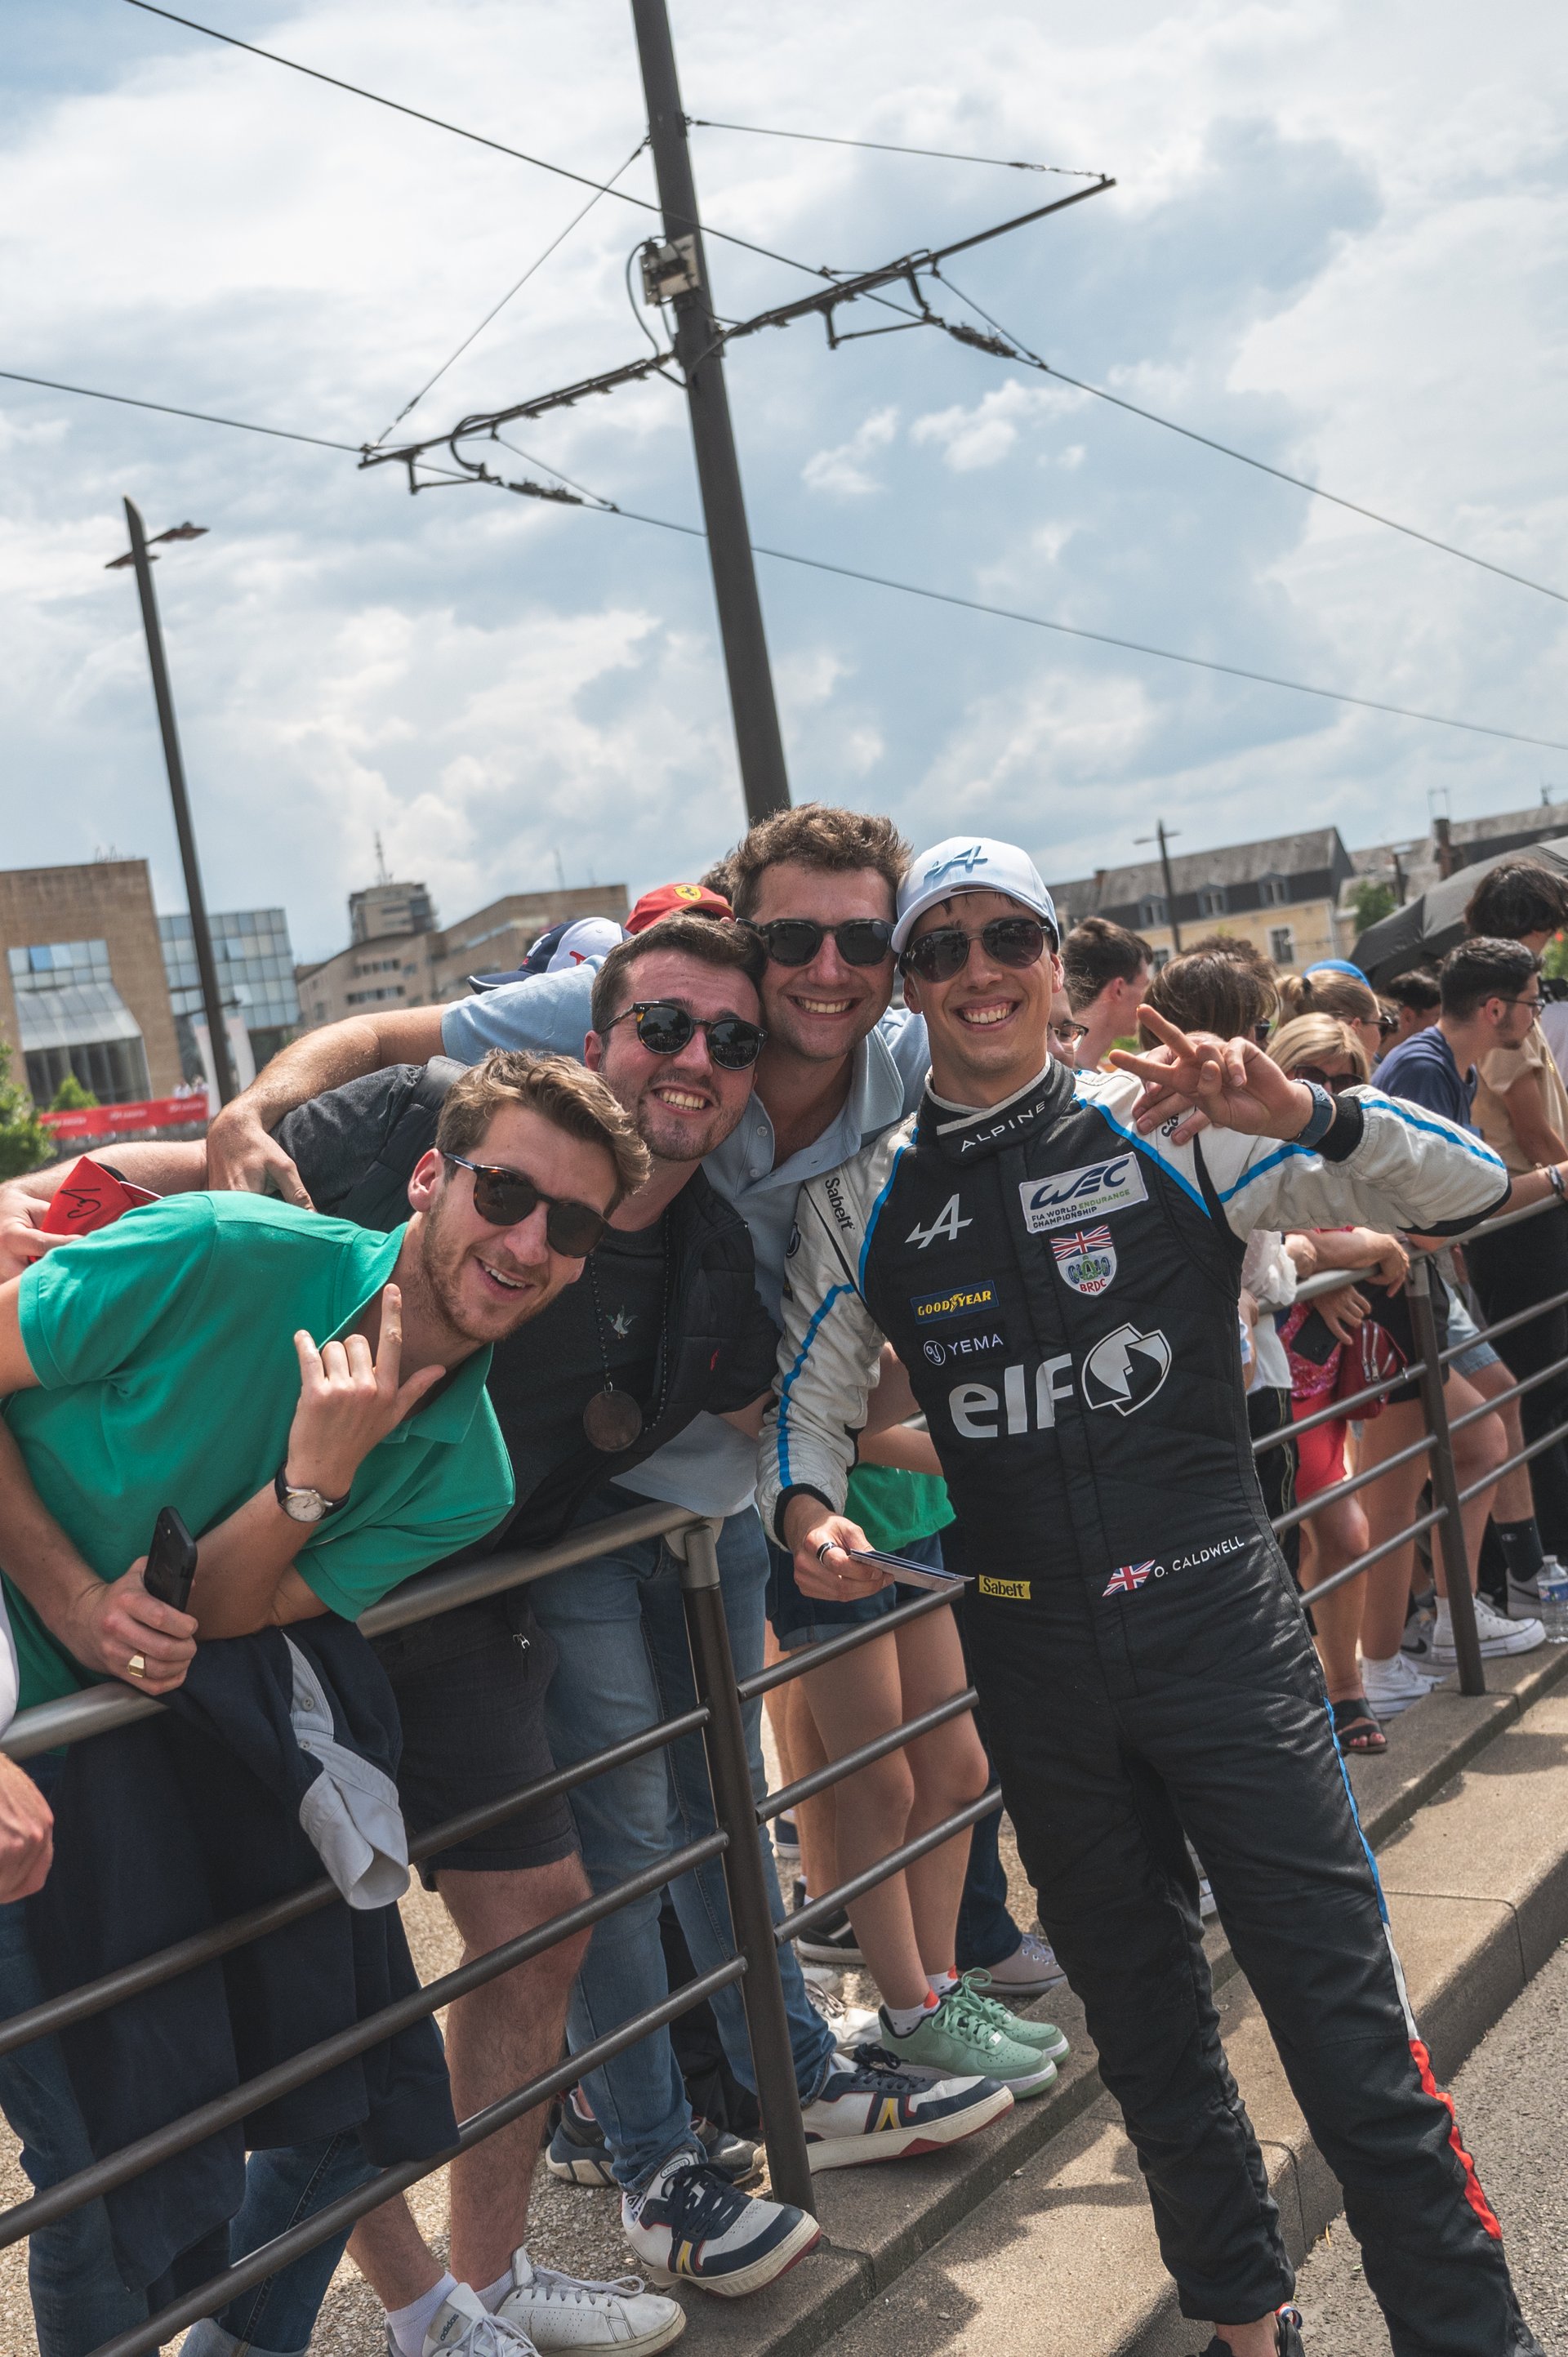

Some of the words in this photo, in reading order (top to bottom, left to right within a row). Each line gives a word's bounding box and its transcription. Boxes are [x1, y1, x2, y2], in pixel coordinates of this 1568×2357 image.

[961, 1101, 1045, 1152] ALPINE
[1031, 1158, 1129, 1210] WEC
[825, 1177, 854, 1231] Sabelt
[1031, 1214, 1045, 1222] FIA
[1046, 1204, 1077, 1218] WORLD
[1079, 1188, 1130, 1210] ENDURANCE
[1033, 1206, 1098, 1228] CHAMPIONSHIP
[1080, 1278, 1107, 1293] BRDC
[917, 1290, 991, 1316] GOODYEAR
[947, 1333, 1004, 1356] YEMA
[949, 1353, 1074, 1438] elf
[1154, 1566, 1169, 1578] O.
[1172, 1536, 1245, 1571] CALDWELL
[983, 1577, 1025, 1597] Sabelt
[440, 2313, 459, 2341] adidas
